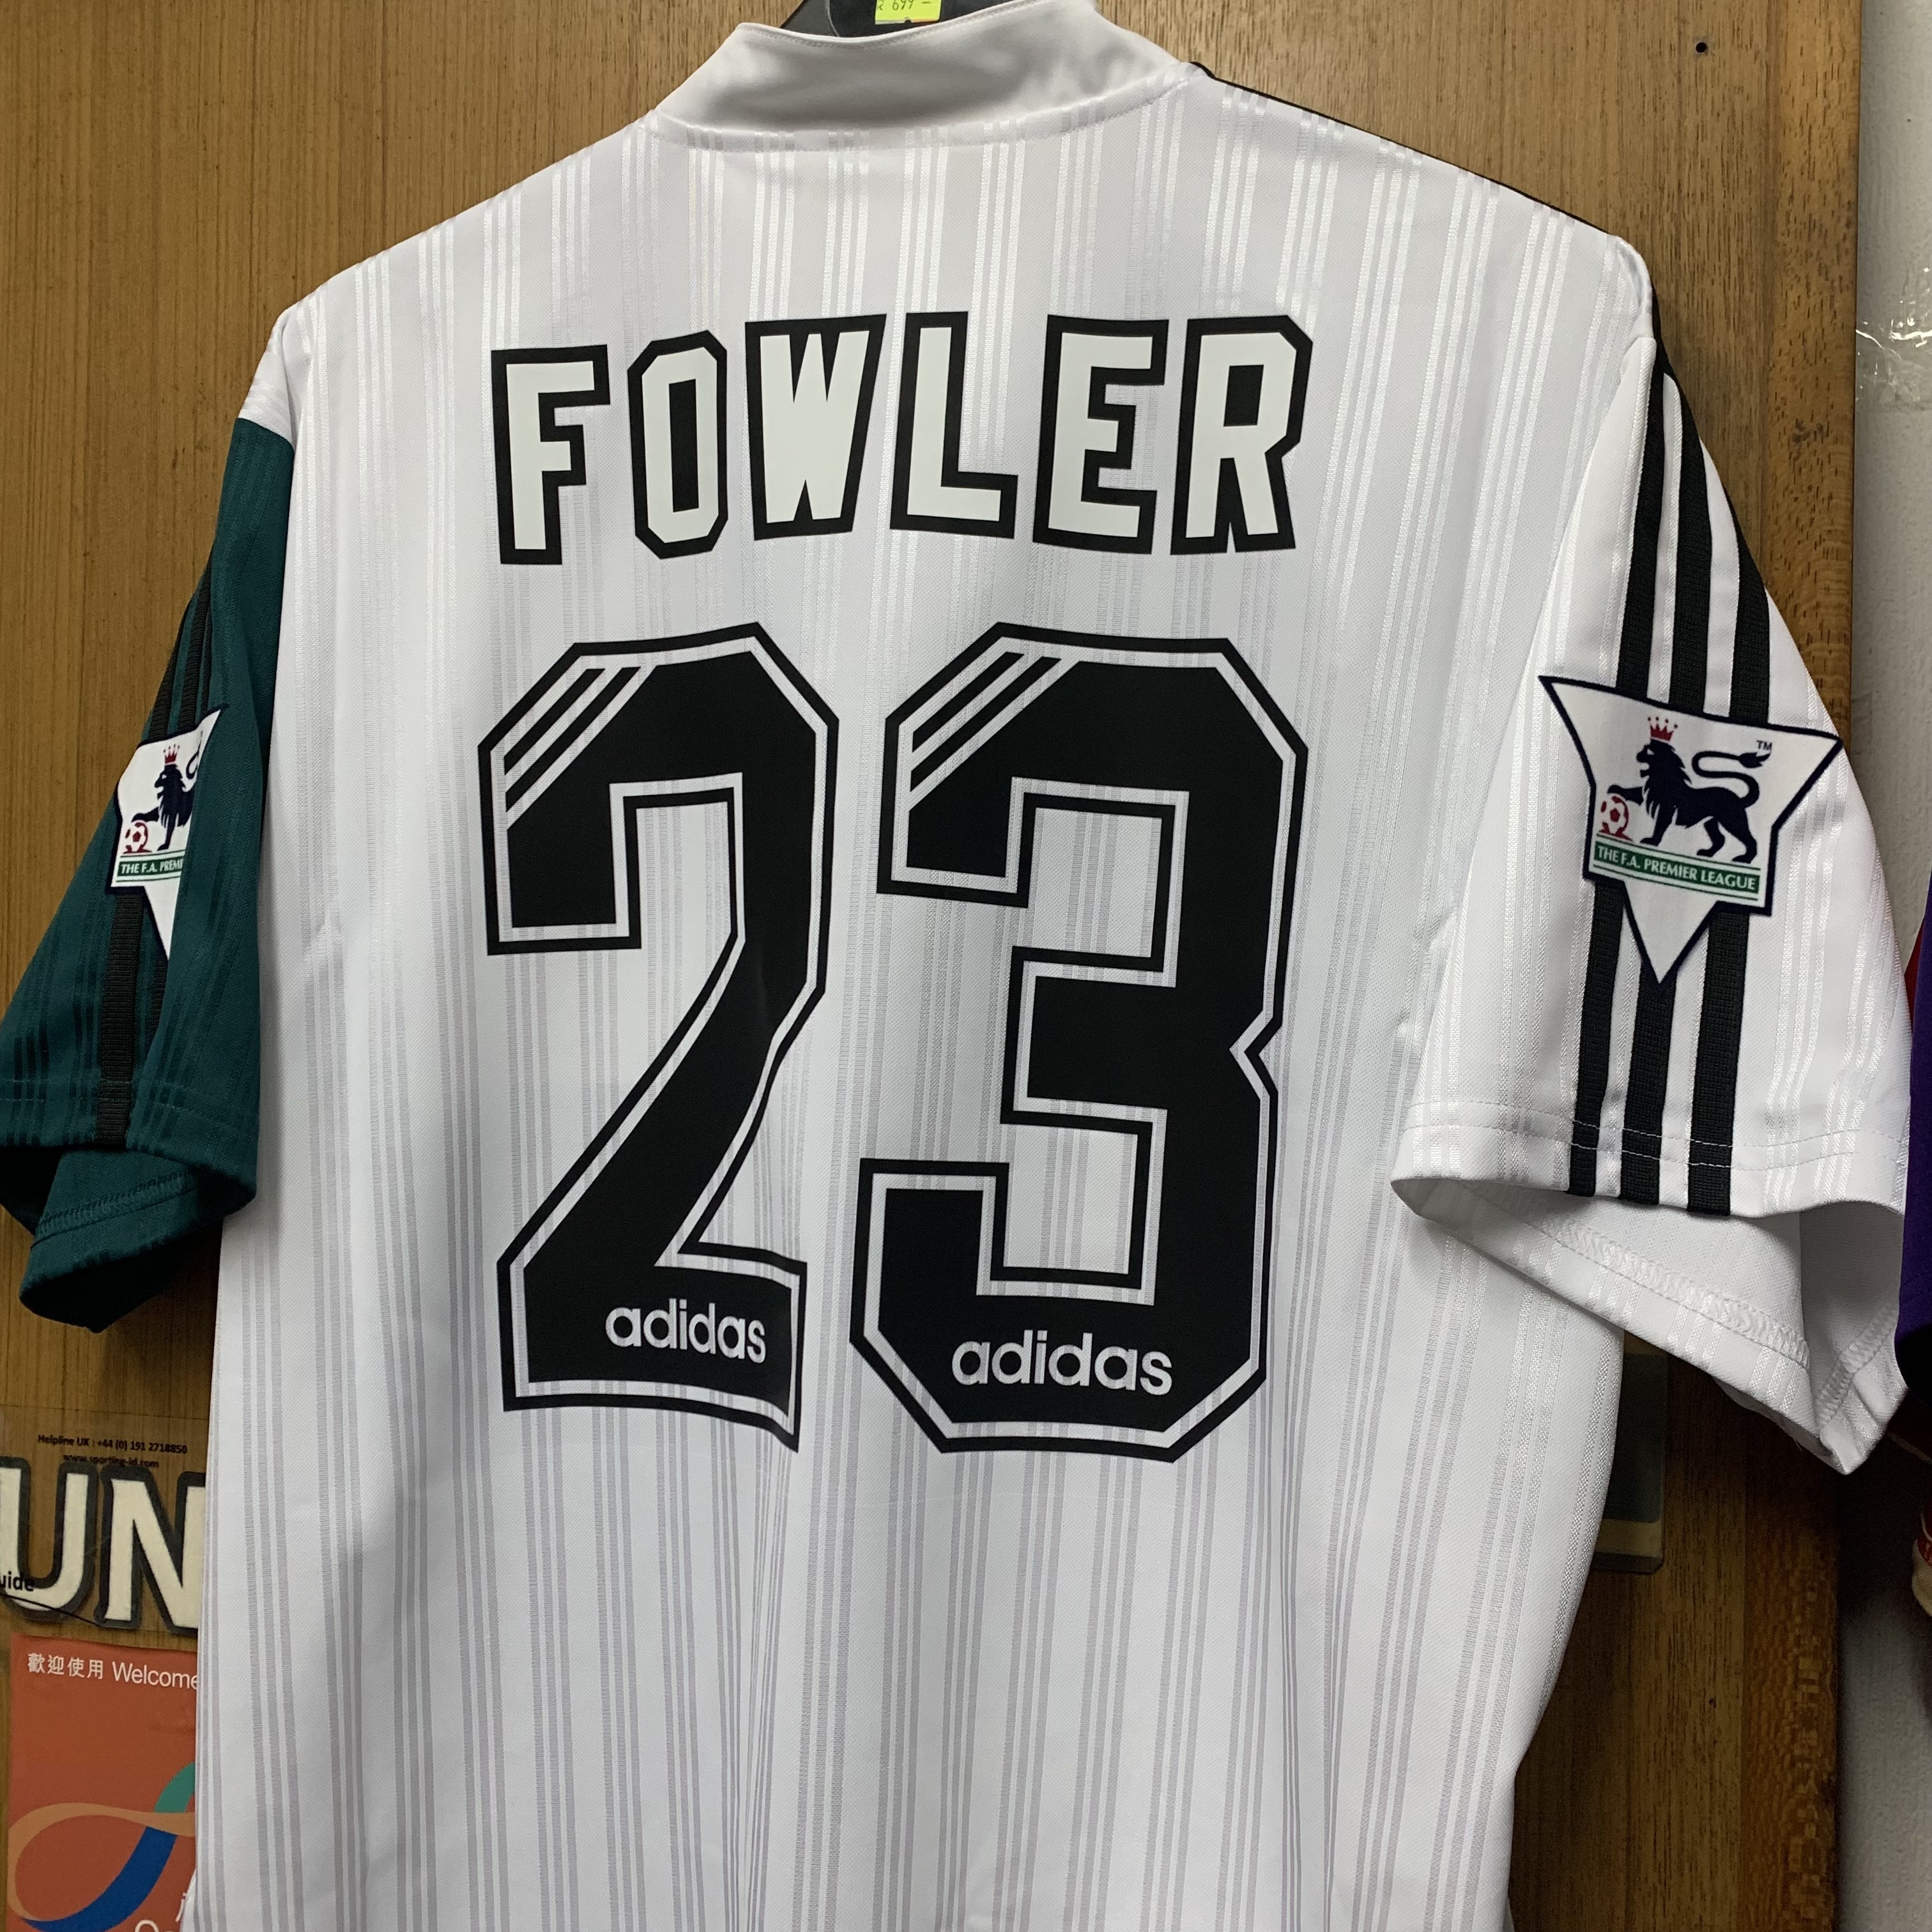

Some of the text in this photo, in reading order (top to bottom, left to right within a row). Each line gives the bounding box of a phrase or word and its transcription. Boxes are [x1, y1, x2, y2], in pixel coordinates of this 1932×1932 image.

[491, 311, 1313, 565] FOWLER
[121, 862, 140, 875] THE
[141, 862, 158, 873] F.A.
[1597, 845, 1756, 891] THE F.A. PREMIER LEAGUE
[478, 622, 1308, 1463] 23
[605, 1298, 766, 1364] adidas
[951, 1329, 1173, 1396] adidas
[37, 1434, 75, 1447] Helpline
[77, 1438, 89, 1446] UK
[97, 1439, 113, 1449] +44
[115, 1440, 128, 1451] (0)
[130, 1441, 146, 1452] 191
[27, 1652, 198, 1690] 歡迎使用 Welcome
